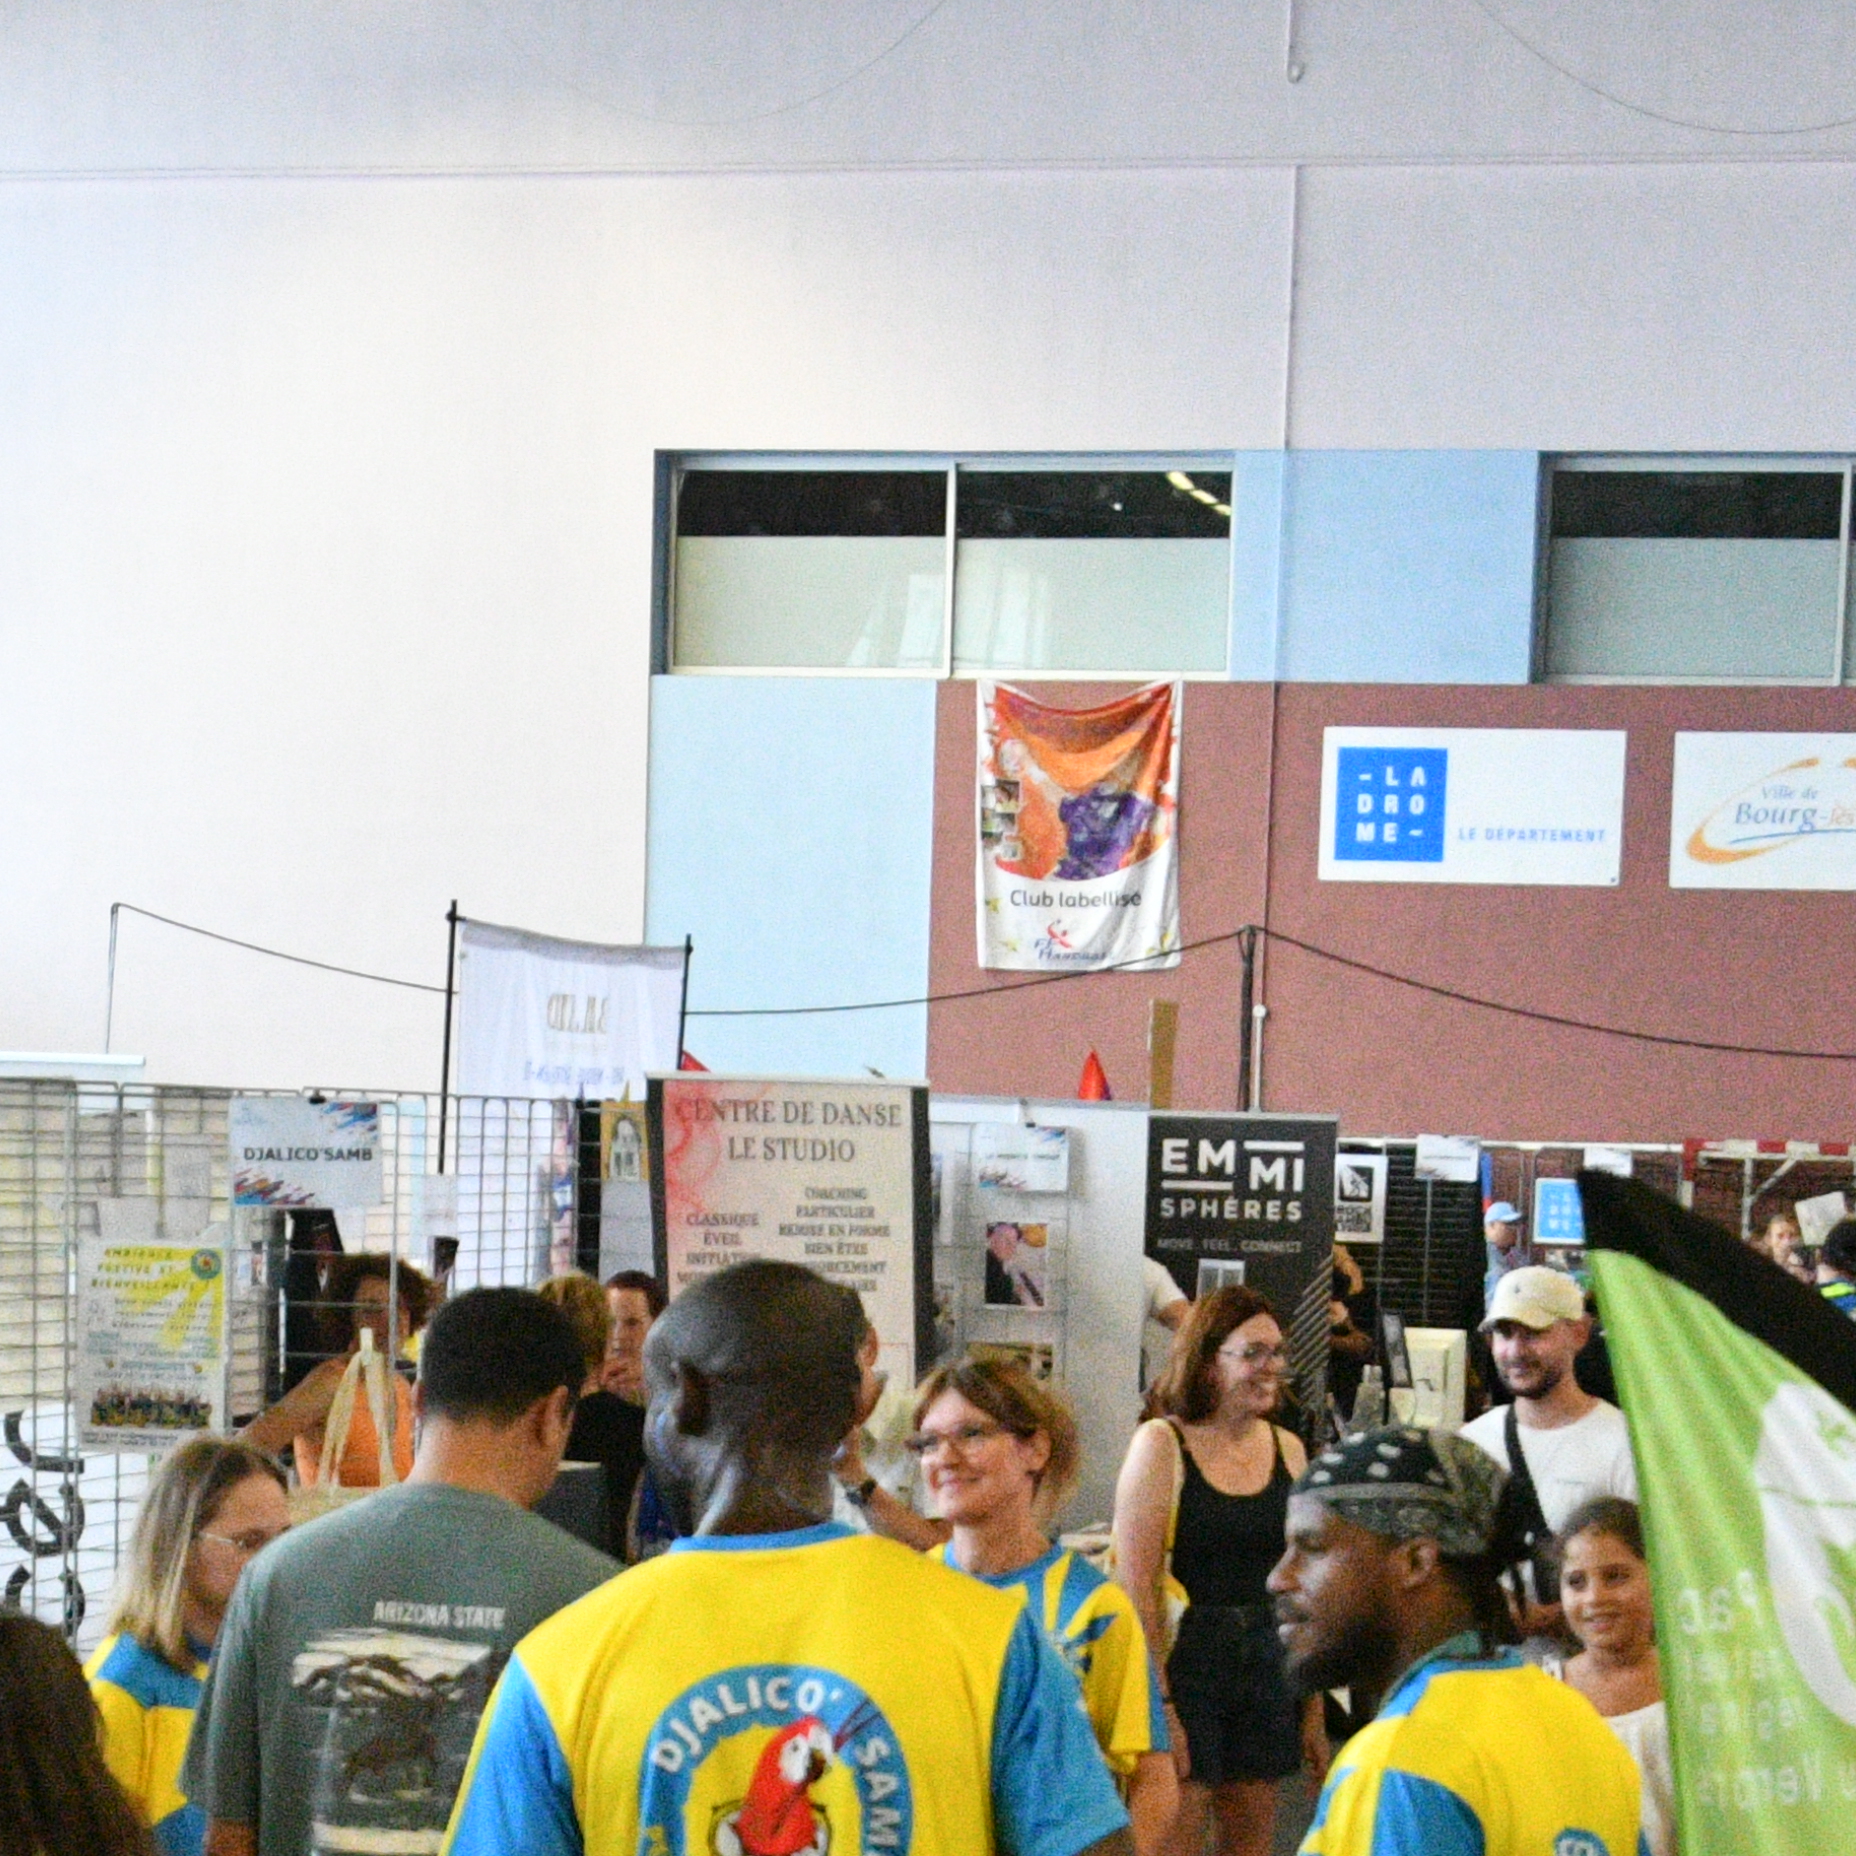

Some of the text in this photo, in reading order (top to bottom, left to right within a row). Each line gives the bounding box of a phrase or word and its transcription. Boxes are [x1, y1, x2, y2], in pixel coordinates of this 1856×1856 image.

[1458, 827, 1476, 841] LE
[1010, 889, 1054, 908] Club
[783, 1101, 814, 1124] DE
[822, 1102, 902, 1127] DANSE
[728, 1136, 856, 1163] LE STUDIO
